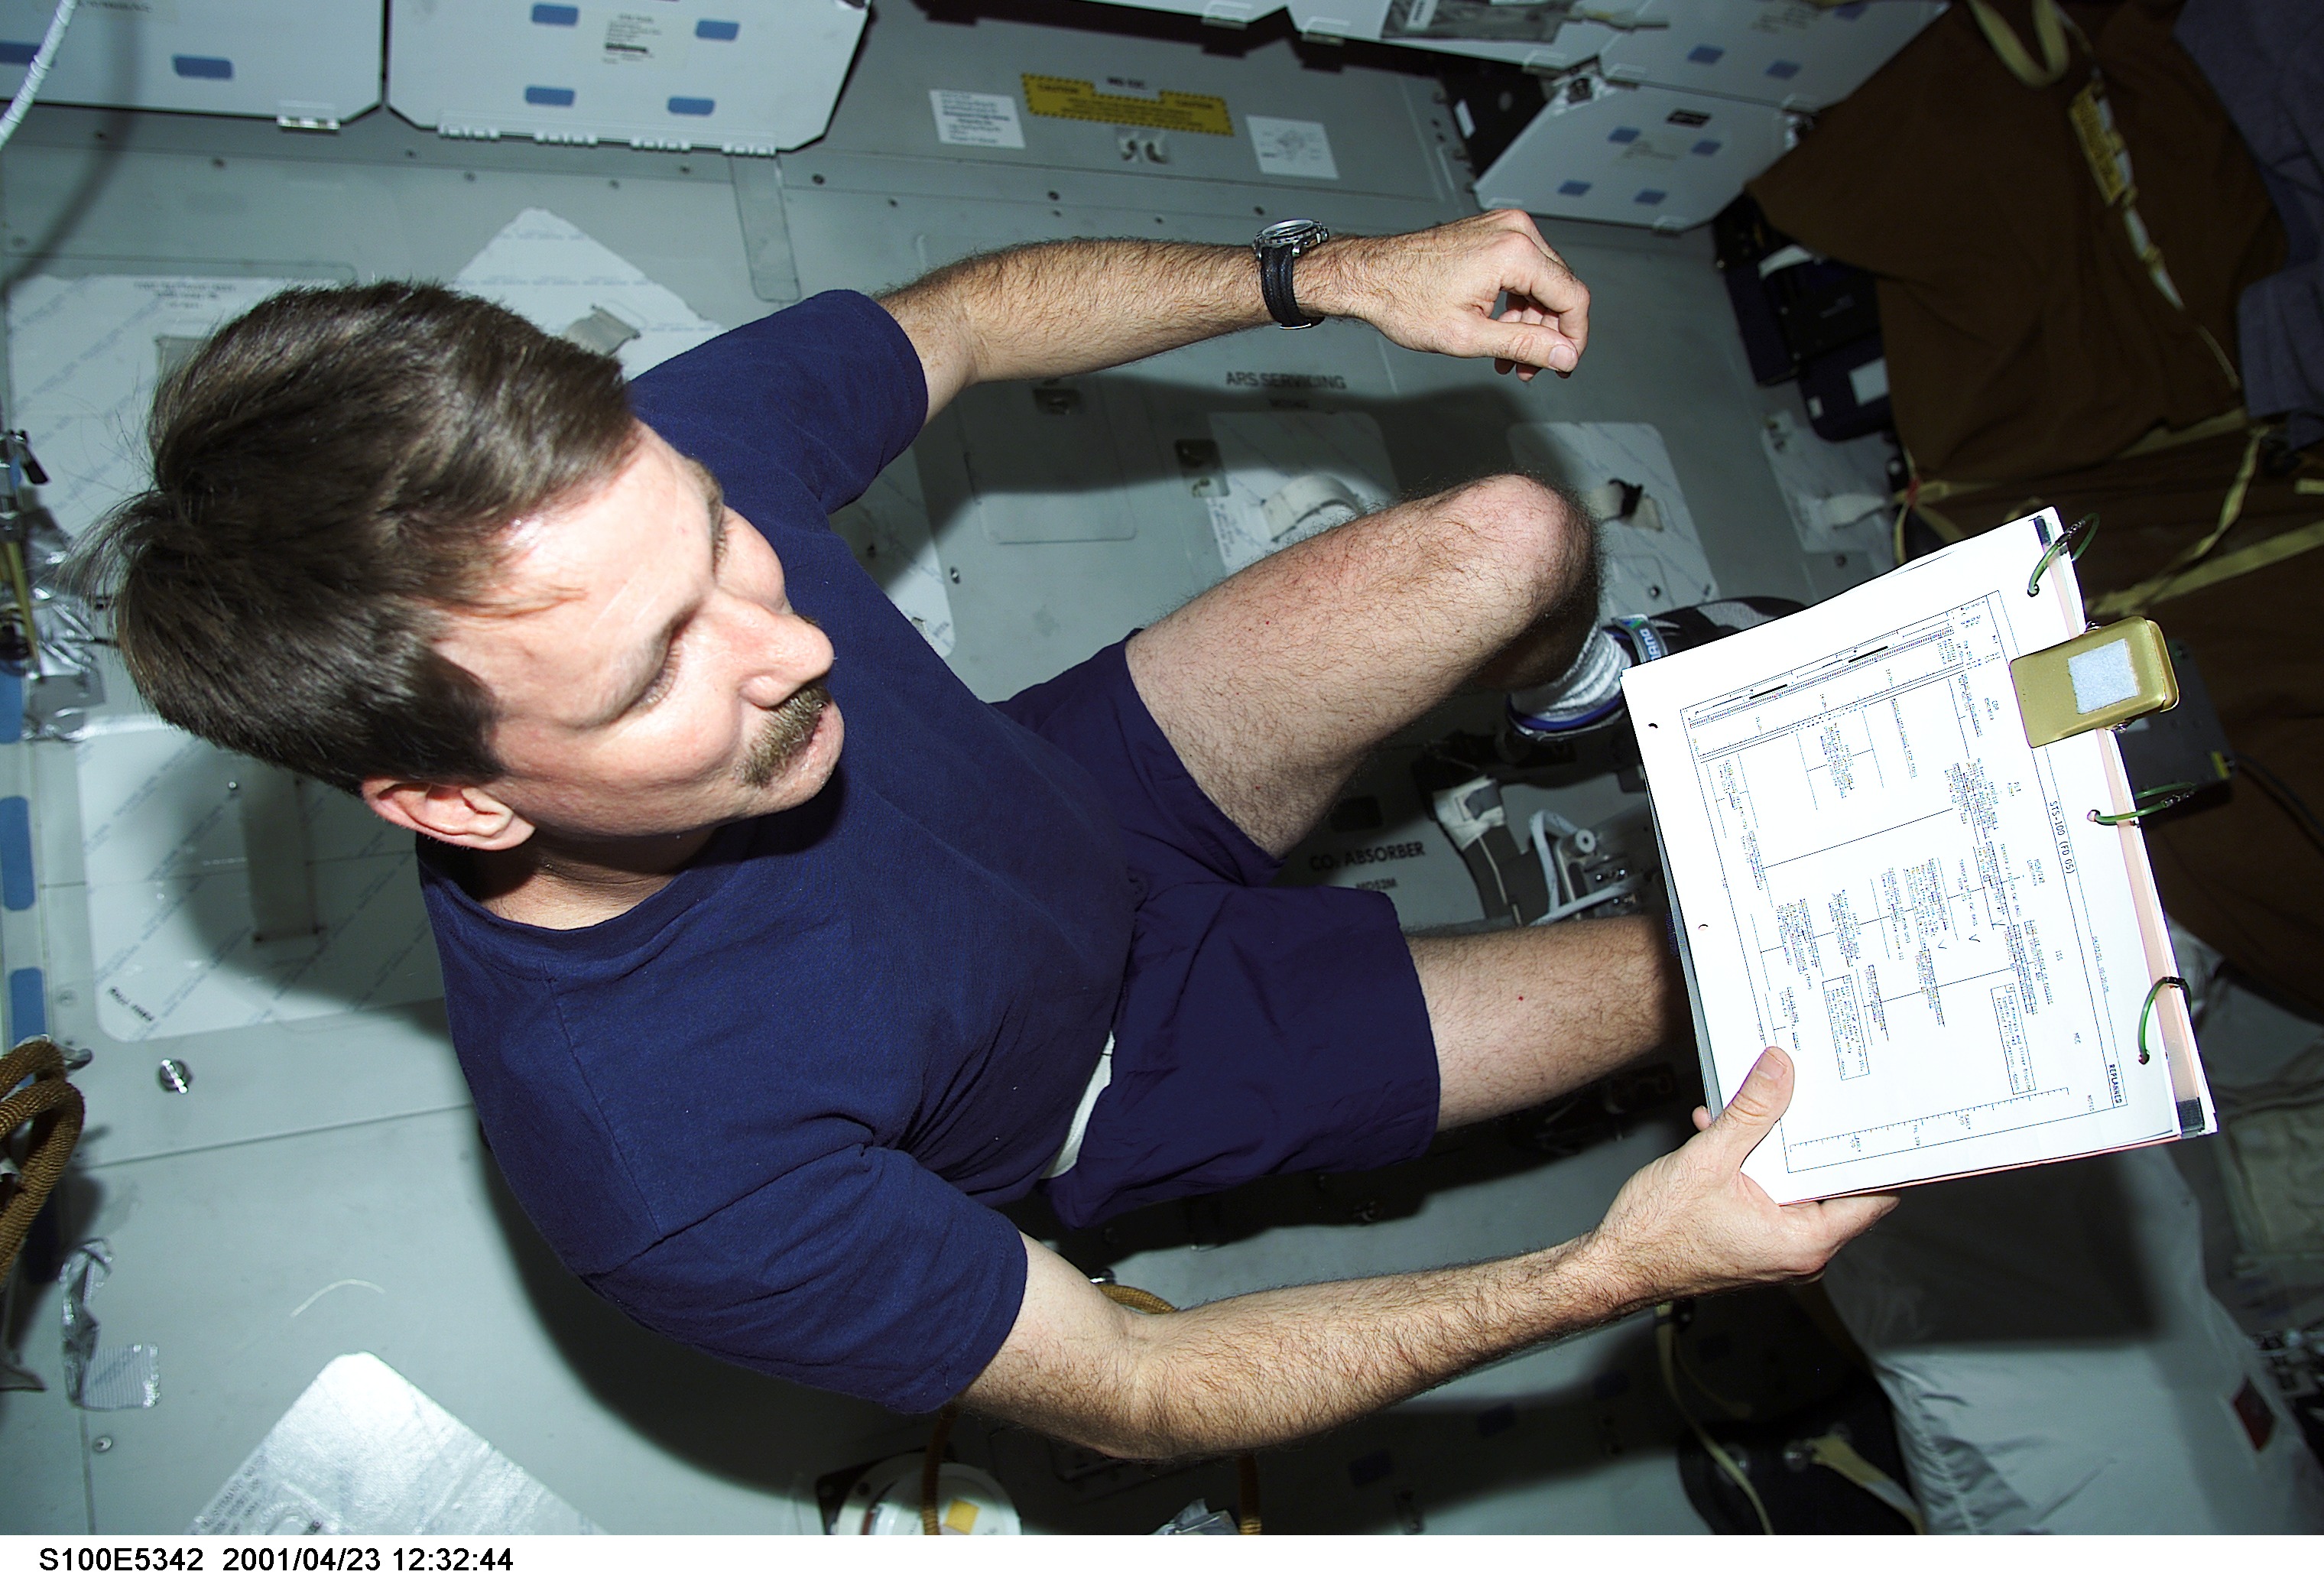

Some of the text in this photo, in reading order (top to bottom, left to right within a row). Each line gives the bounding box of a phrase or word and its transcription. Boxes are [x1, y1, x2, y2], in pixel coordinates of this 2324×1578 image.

[1344, 841, 1426, 867] ABSORBER
[2049, 800, 2075, 875] STS-100 (FD 05)
[2105, 1063, 2124, 1104] REPLANNED
